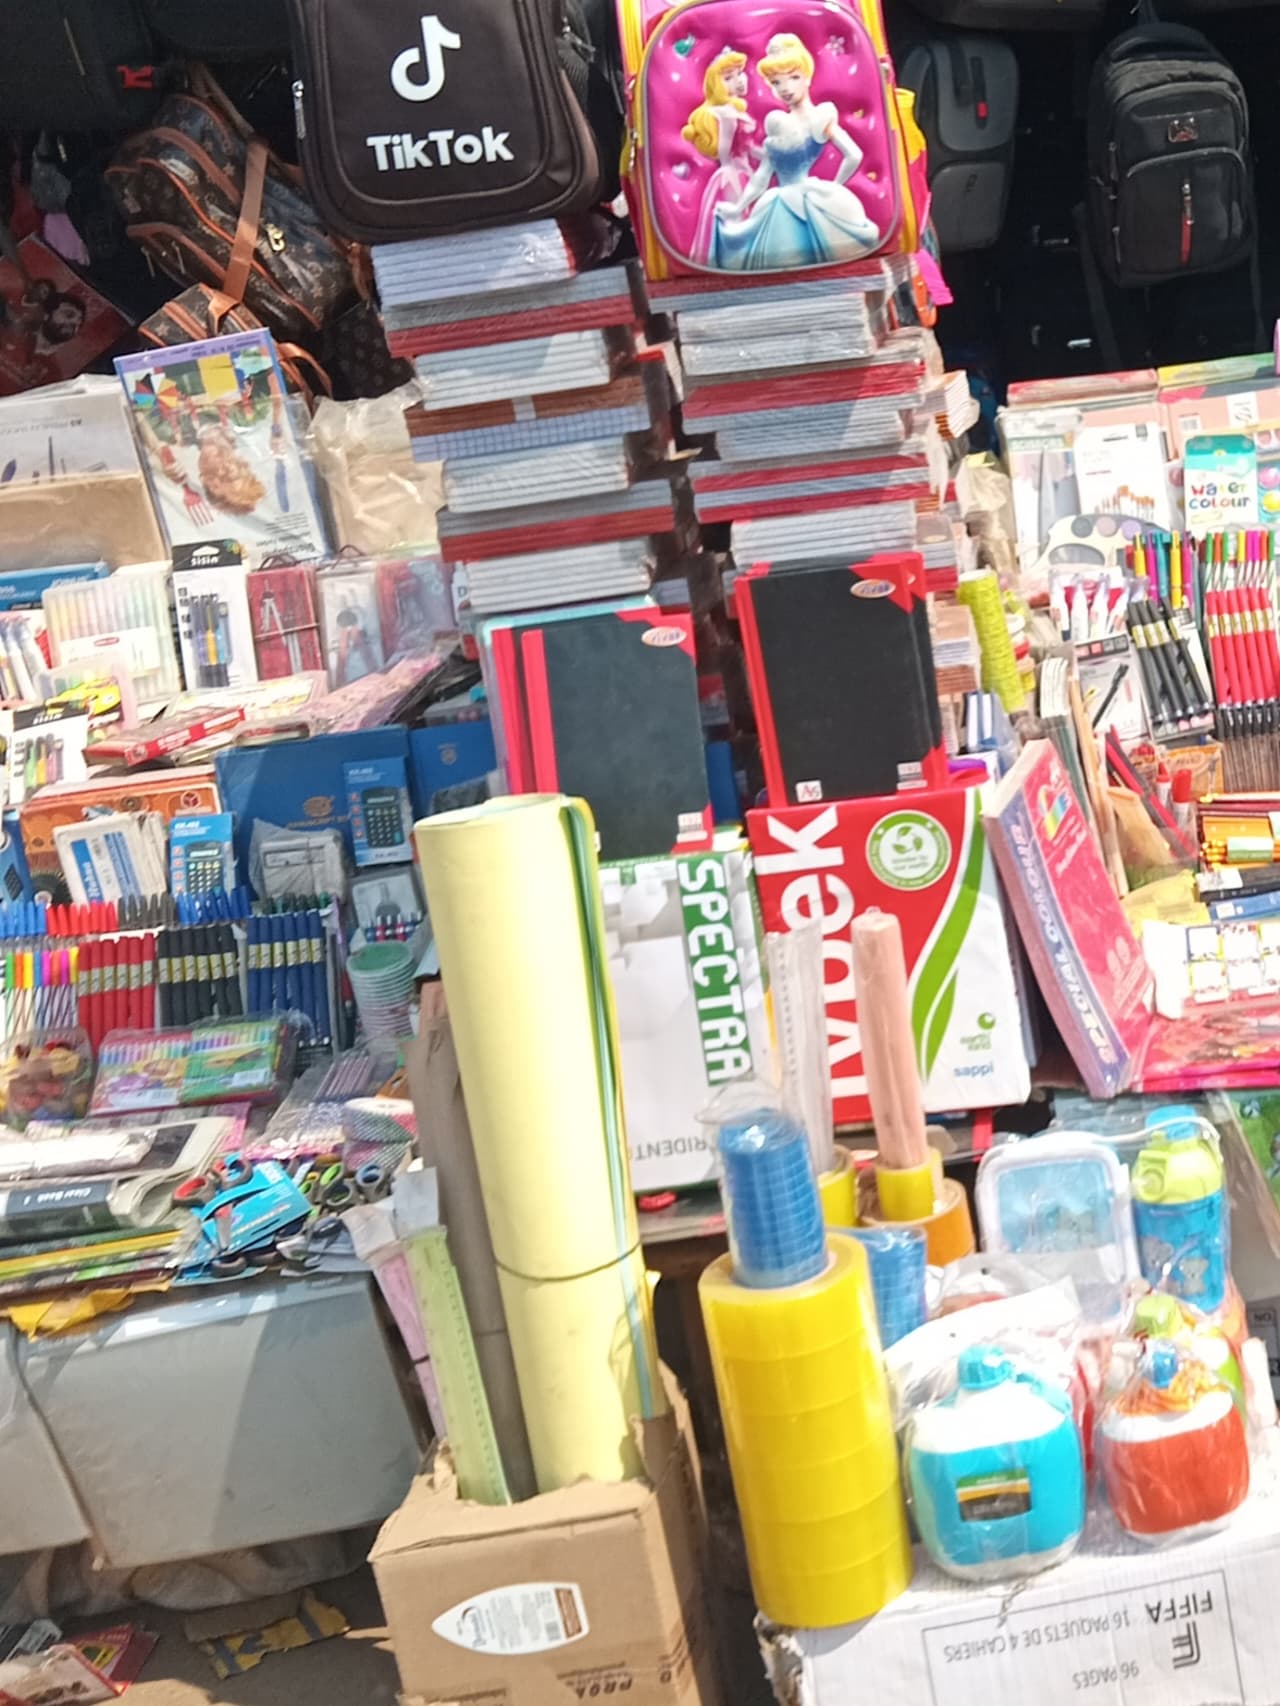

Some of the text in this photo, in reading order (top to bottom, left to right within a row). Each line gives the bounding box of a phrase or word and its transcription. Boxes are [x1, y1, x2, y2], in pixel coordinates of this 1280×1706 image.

[366, 126, 514, 171] TikTok
[678, 858, 753, 1086] SPECTRA
[1145, 1590, 1213, 1624] FIFFA
[943, 1609, 1131, 1663] 16 PAQUETS DE 4 CAHIERS
[1072, 1660, 1140, 1690] 96 PAGES
